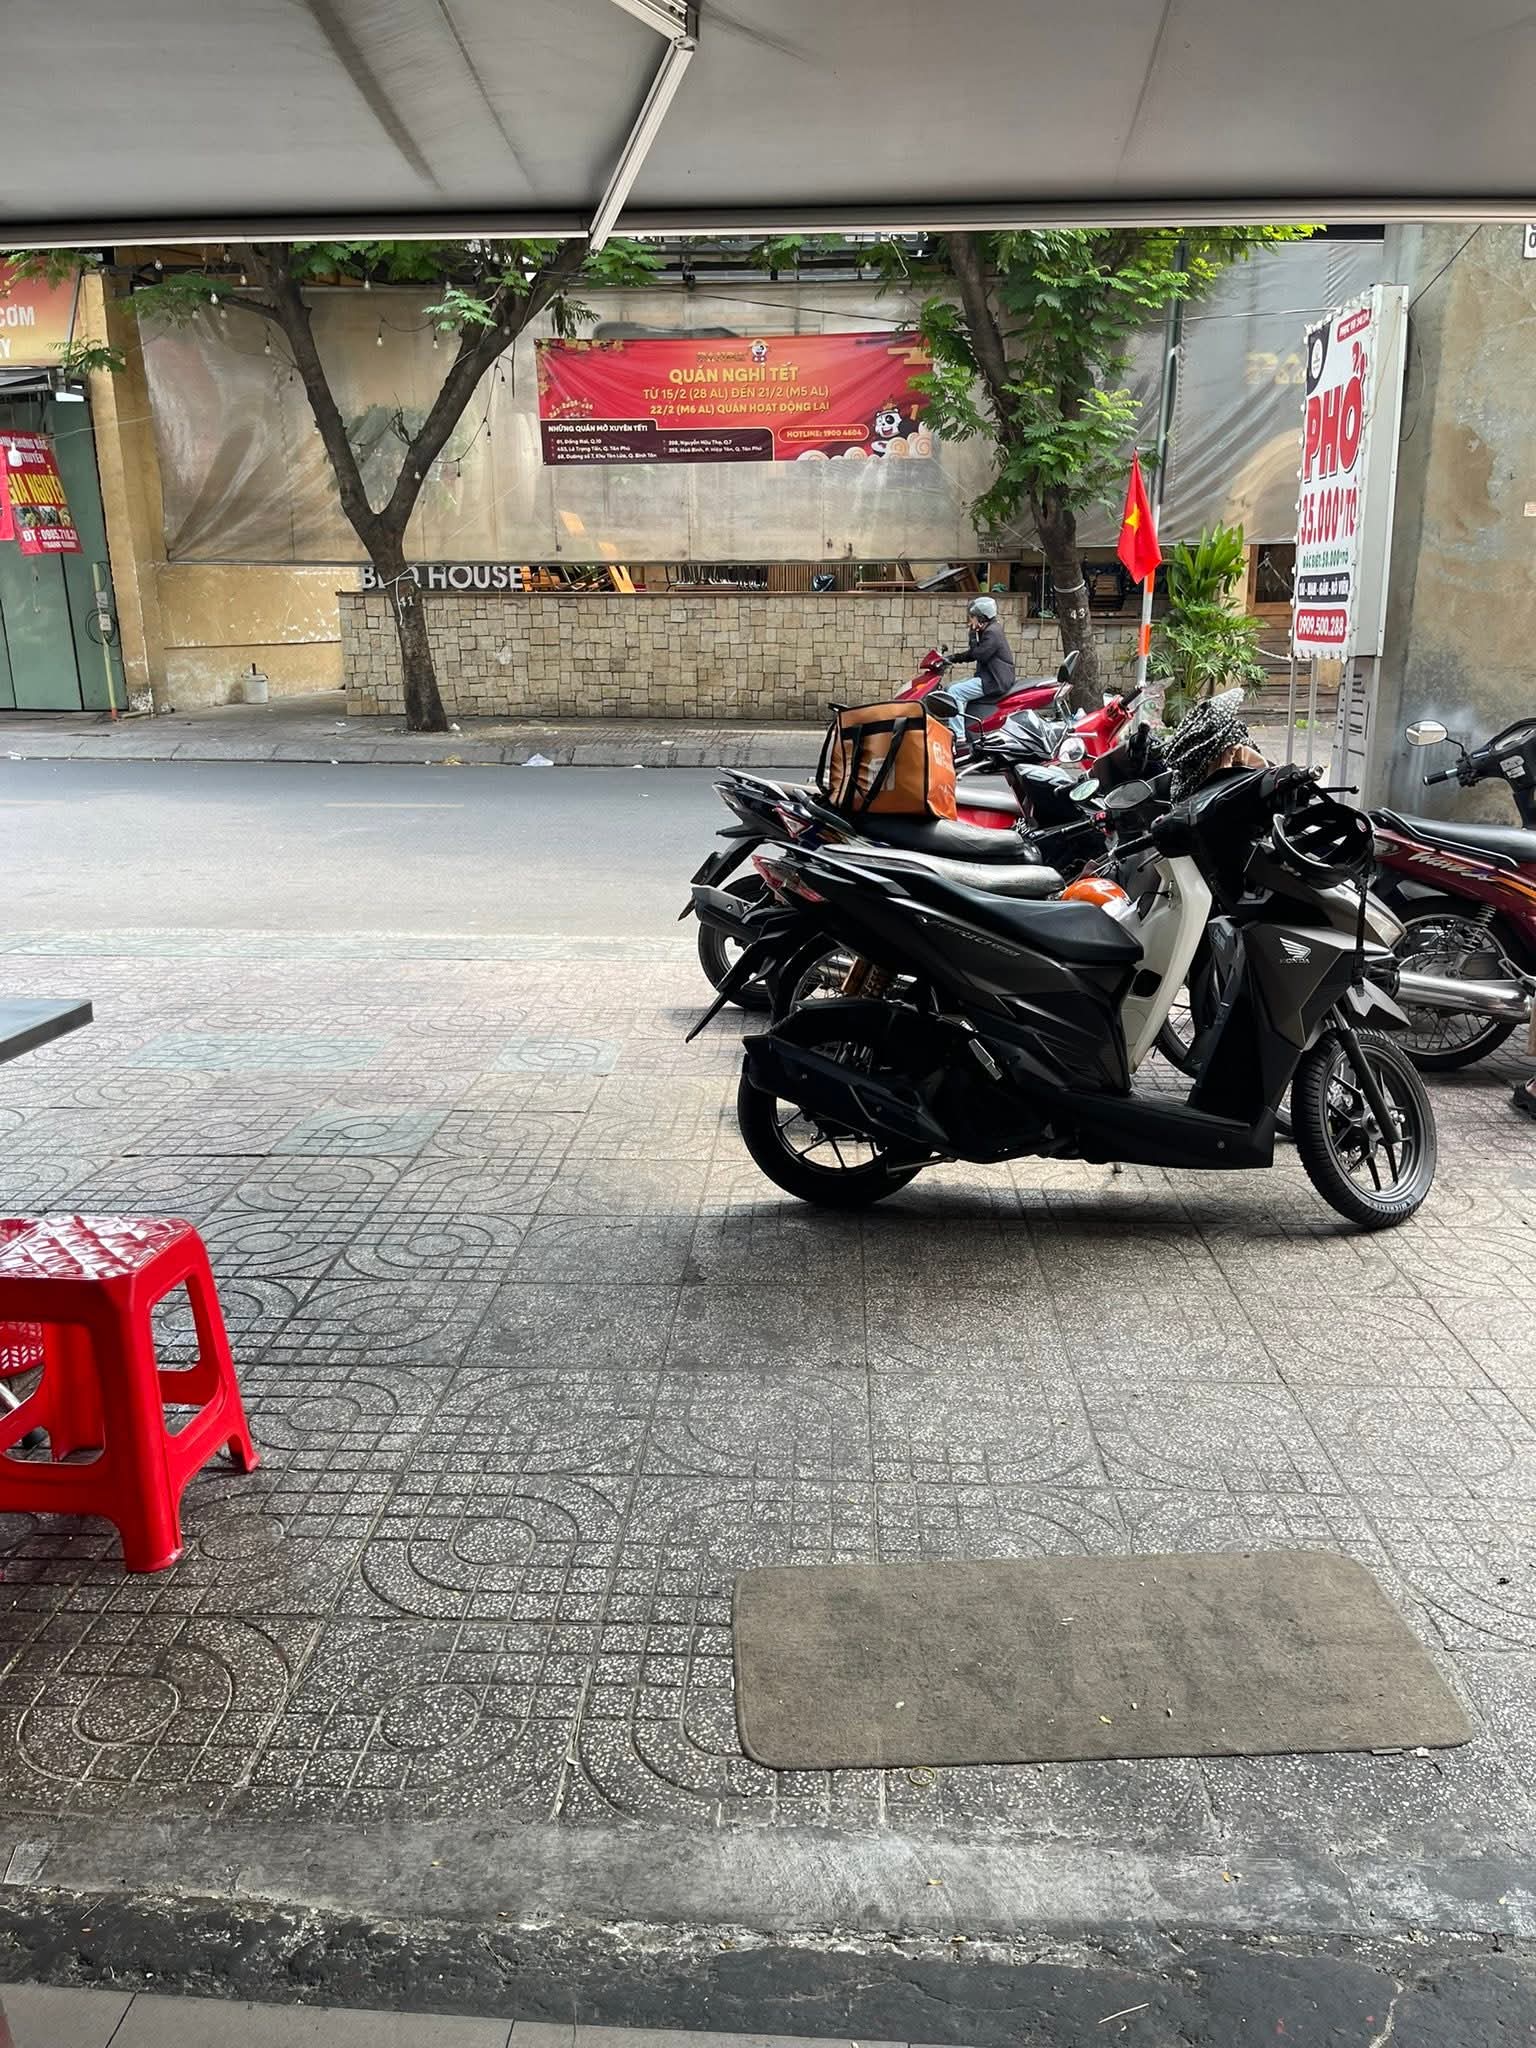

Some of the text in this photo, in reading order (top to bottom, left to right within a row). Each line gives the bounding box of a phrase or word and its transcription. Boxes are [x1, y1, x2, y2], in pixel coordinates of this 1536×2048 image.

[669, 362, 798, 384] QUÁN NGHỈ TẾT
[643, 385, 829, 401] TỪ 15/2 (28 AL) ĐẾN 21/2 (M5 AL)
[650, 400, 830, 416] 22/2 (M6 AL) QUÁN HOẠT ĐỘNG LẠI
[1304, 341, 1367, 483] PHỞ
[548, 423, 574, 432] NHỮNG
[575, 423, 595, 432] QUÁN
[596, 423, 609, 432] MỞ
[609, 423, 633, 432] XUYÊN
[786, 430, 822, 439] HOTLINE:
[428, 566, 523, 588] HOUSE
[1298, 615, 1345, 636] 0909.500.288
